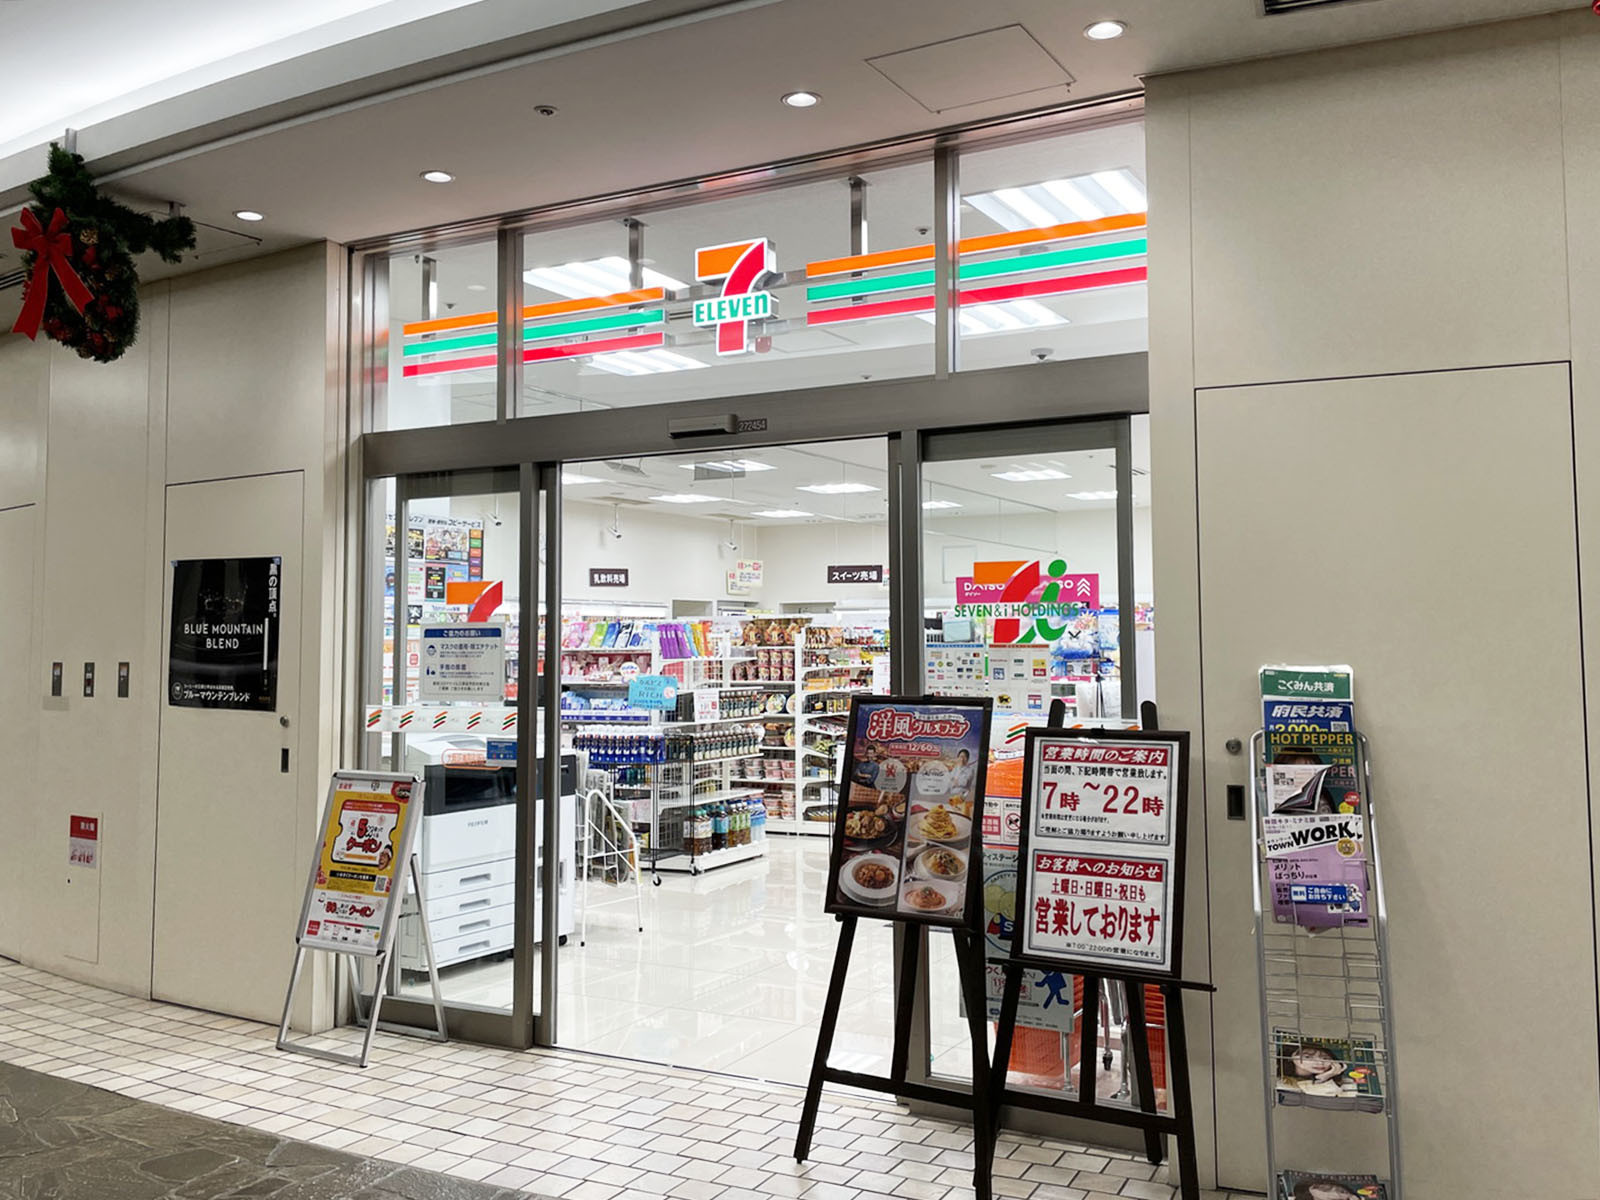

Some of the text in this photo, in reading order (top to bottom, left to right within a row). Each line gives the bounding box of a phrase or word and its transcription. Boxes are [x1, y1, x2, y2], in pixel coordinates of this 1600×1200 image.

[738, 420, 766, 432] 272454
[832, 570, 878, 581] スイーツ売場
[1011, 602, 1080, 618] HOLDINGS
[184, 623, 263, 635] BLUE MOUNTAIN
[205, 638, 239, 649] BLEND
[1277, 679, 1335, 693] こくみん共済
[183, 690, 251, 703] ブルーマウンテンブレンド
[1272, 704, 1343, 718] 府民共済
[869, 711, 967, 737] 洋風グルメフェア
[1270, 733, 1354, 745] HOT PEPPER
[1044, 746, 1165, 764] 営業時間のご案内
[1043, 765, 1167, 780] 当面の間、下記時間帯で営業致します。
[1268, 840, 1295, 852] TOWN
[1038, 857, 1161, 879] お客様へのお知らせ
[1051, 877, 1146, 902] 土曜日・日曜日・祝日も
[1035, 896, 1160, 946] 営業しております
